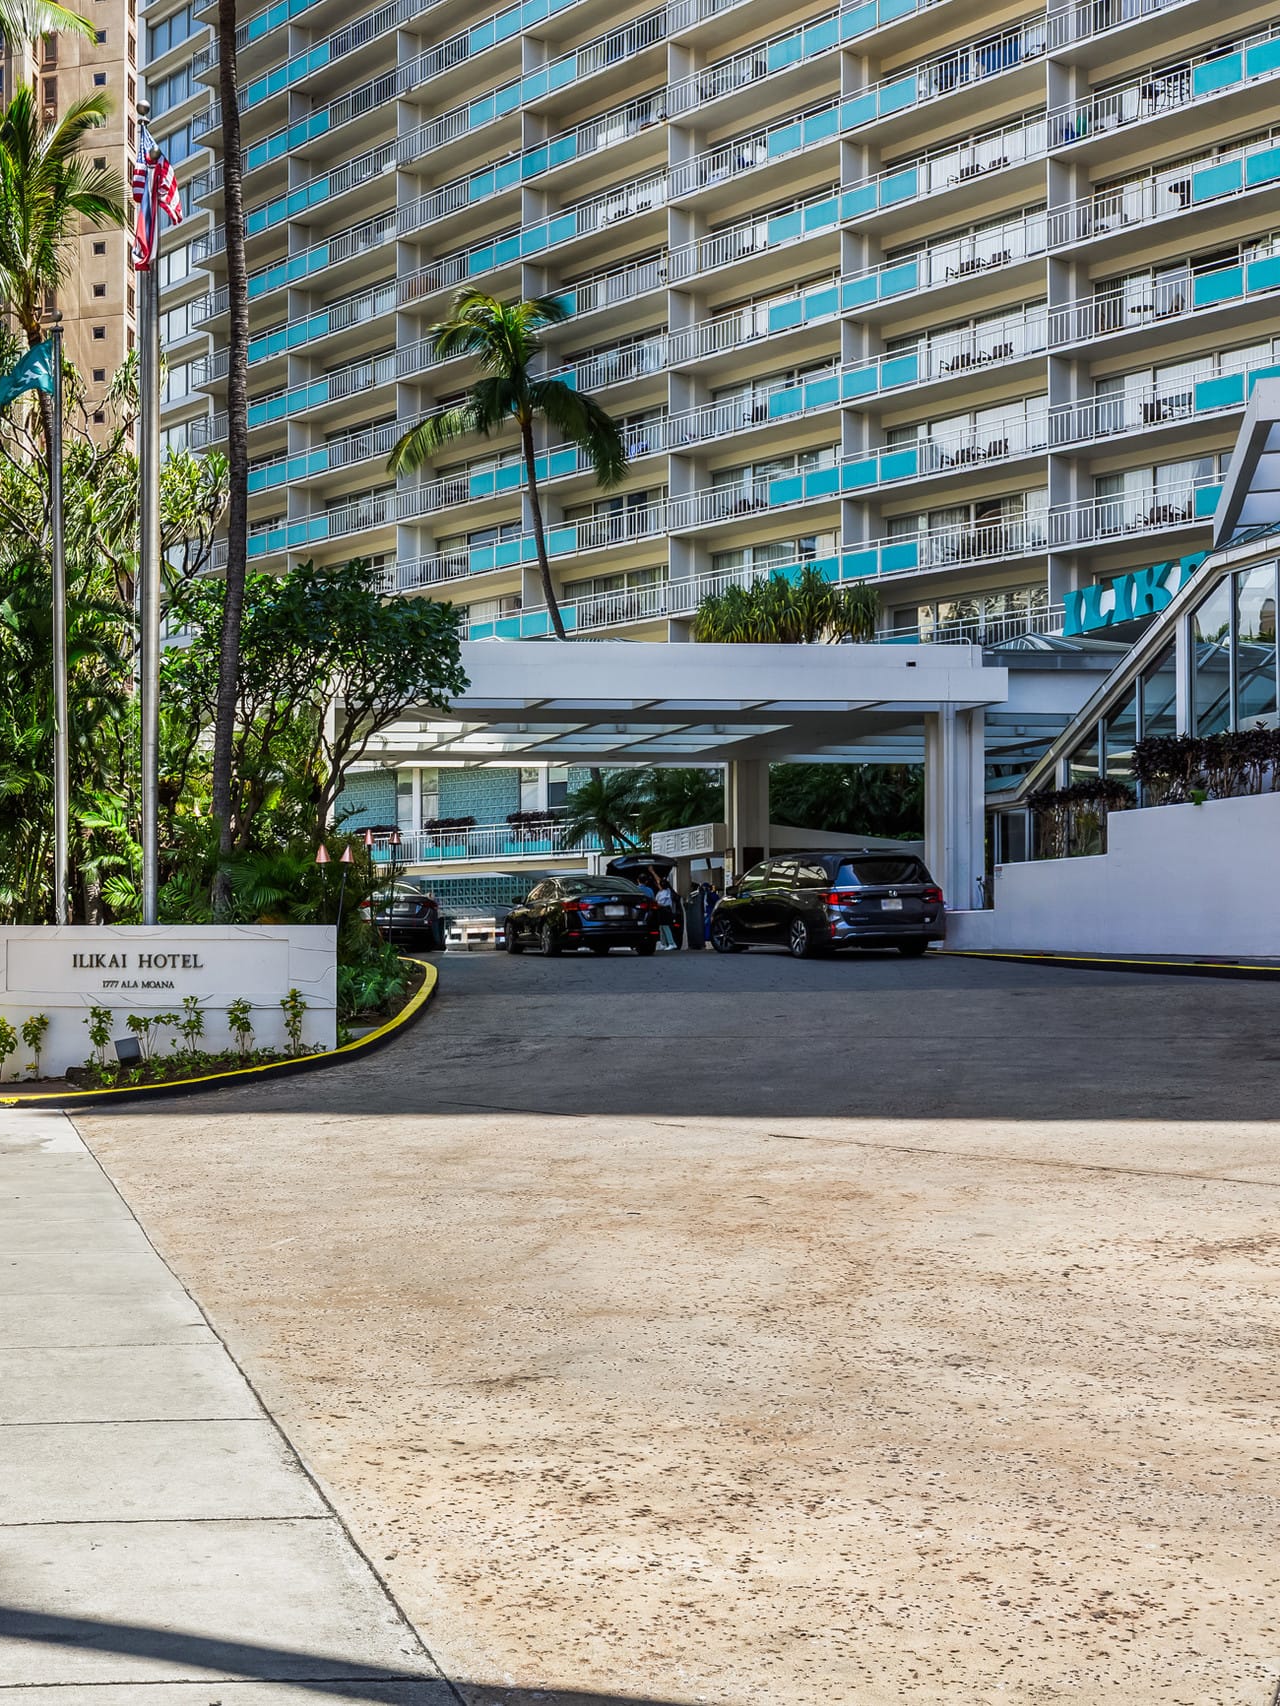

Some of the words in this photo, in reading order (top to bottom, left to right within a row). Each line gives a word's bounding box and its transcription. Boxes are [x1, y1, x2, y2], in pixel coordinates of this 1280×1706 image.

[72, 953, 127, 969] ILIKAI
[138, 953, 204, 969] HOTEL
[102, 980, 120, 989] 1777
[120, 980, 139, 989] ALA
[141, 980, 175, 989] MOANA
